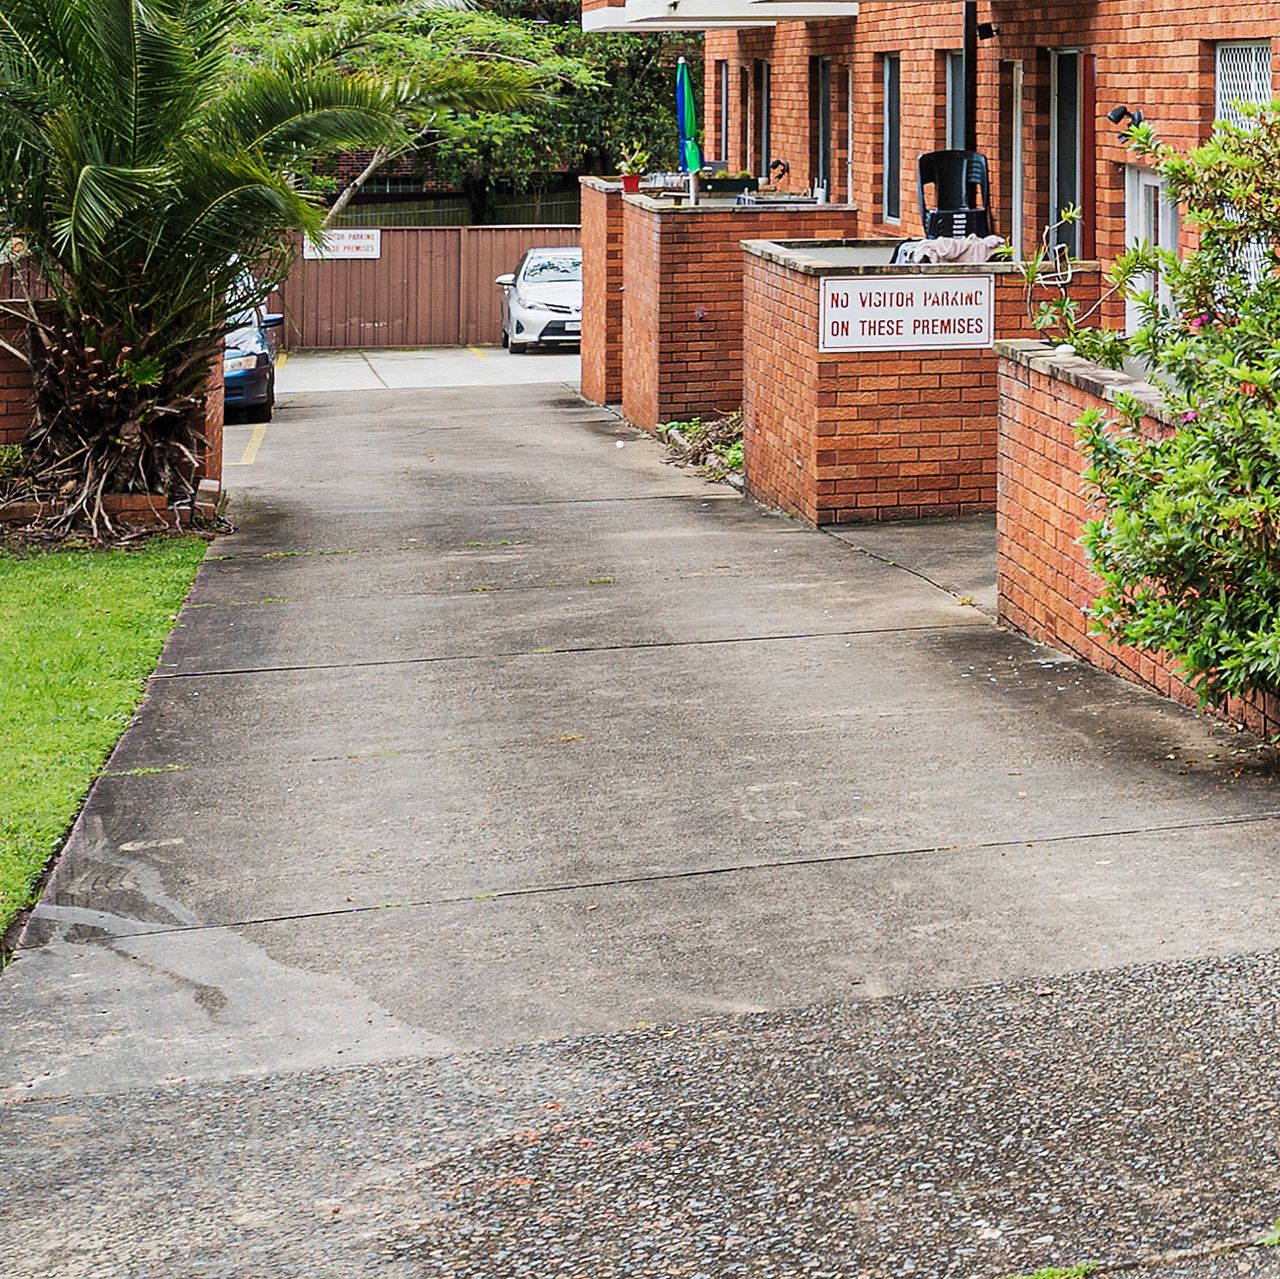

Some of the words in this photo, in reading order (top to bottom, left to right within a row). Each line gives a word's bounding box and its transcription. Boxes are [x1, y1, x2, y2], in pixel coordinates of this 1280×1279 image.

[831, 292, 849, 309] NO
[859, 291, 914, 308] VISITOR
[831, 320, 849, 337] ON
[859, 319, 904, 336] THESE
[912, 317, 983, 335] PREMISES
